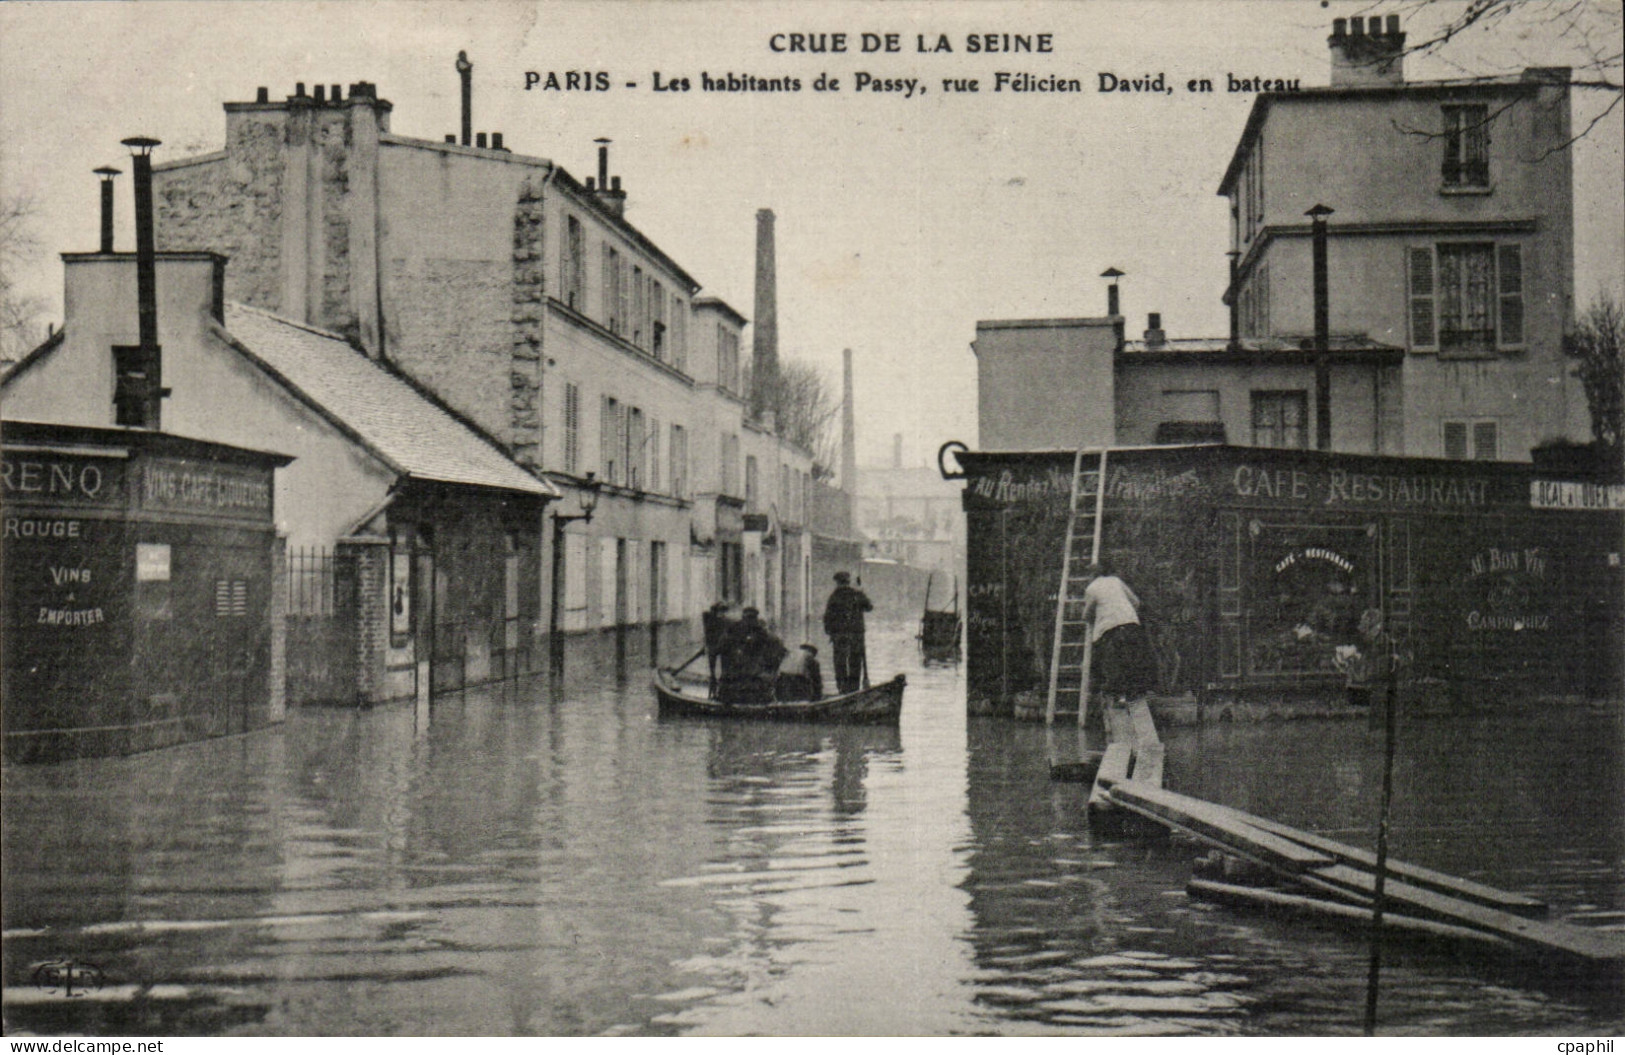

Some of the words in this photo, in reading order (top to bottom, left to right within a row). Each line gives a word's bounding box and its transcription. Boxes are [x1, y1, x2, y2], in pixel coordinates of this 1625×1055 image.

[1325, 468, 1488, 506] RESTAURANT
[1531, 481, 1565, 506] OCAL
[3, 517, 81, 539] ROUGE
[1305, 547, 1354, 574] RESTAURANT
[1489, 547, 1519, 573] BON
[50, 566, 92, 586] VINS
[37, 607, 104, 626] EMPORTER
